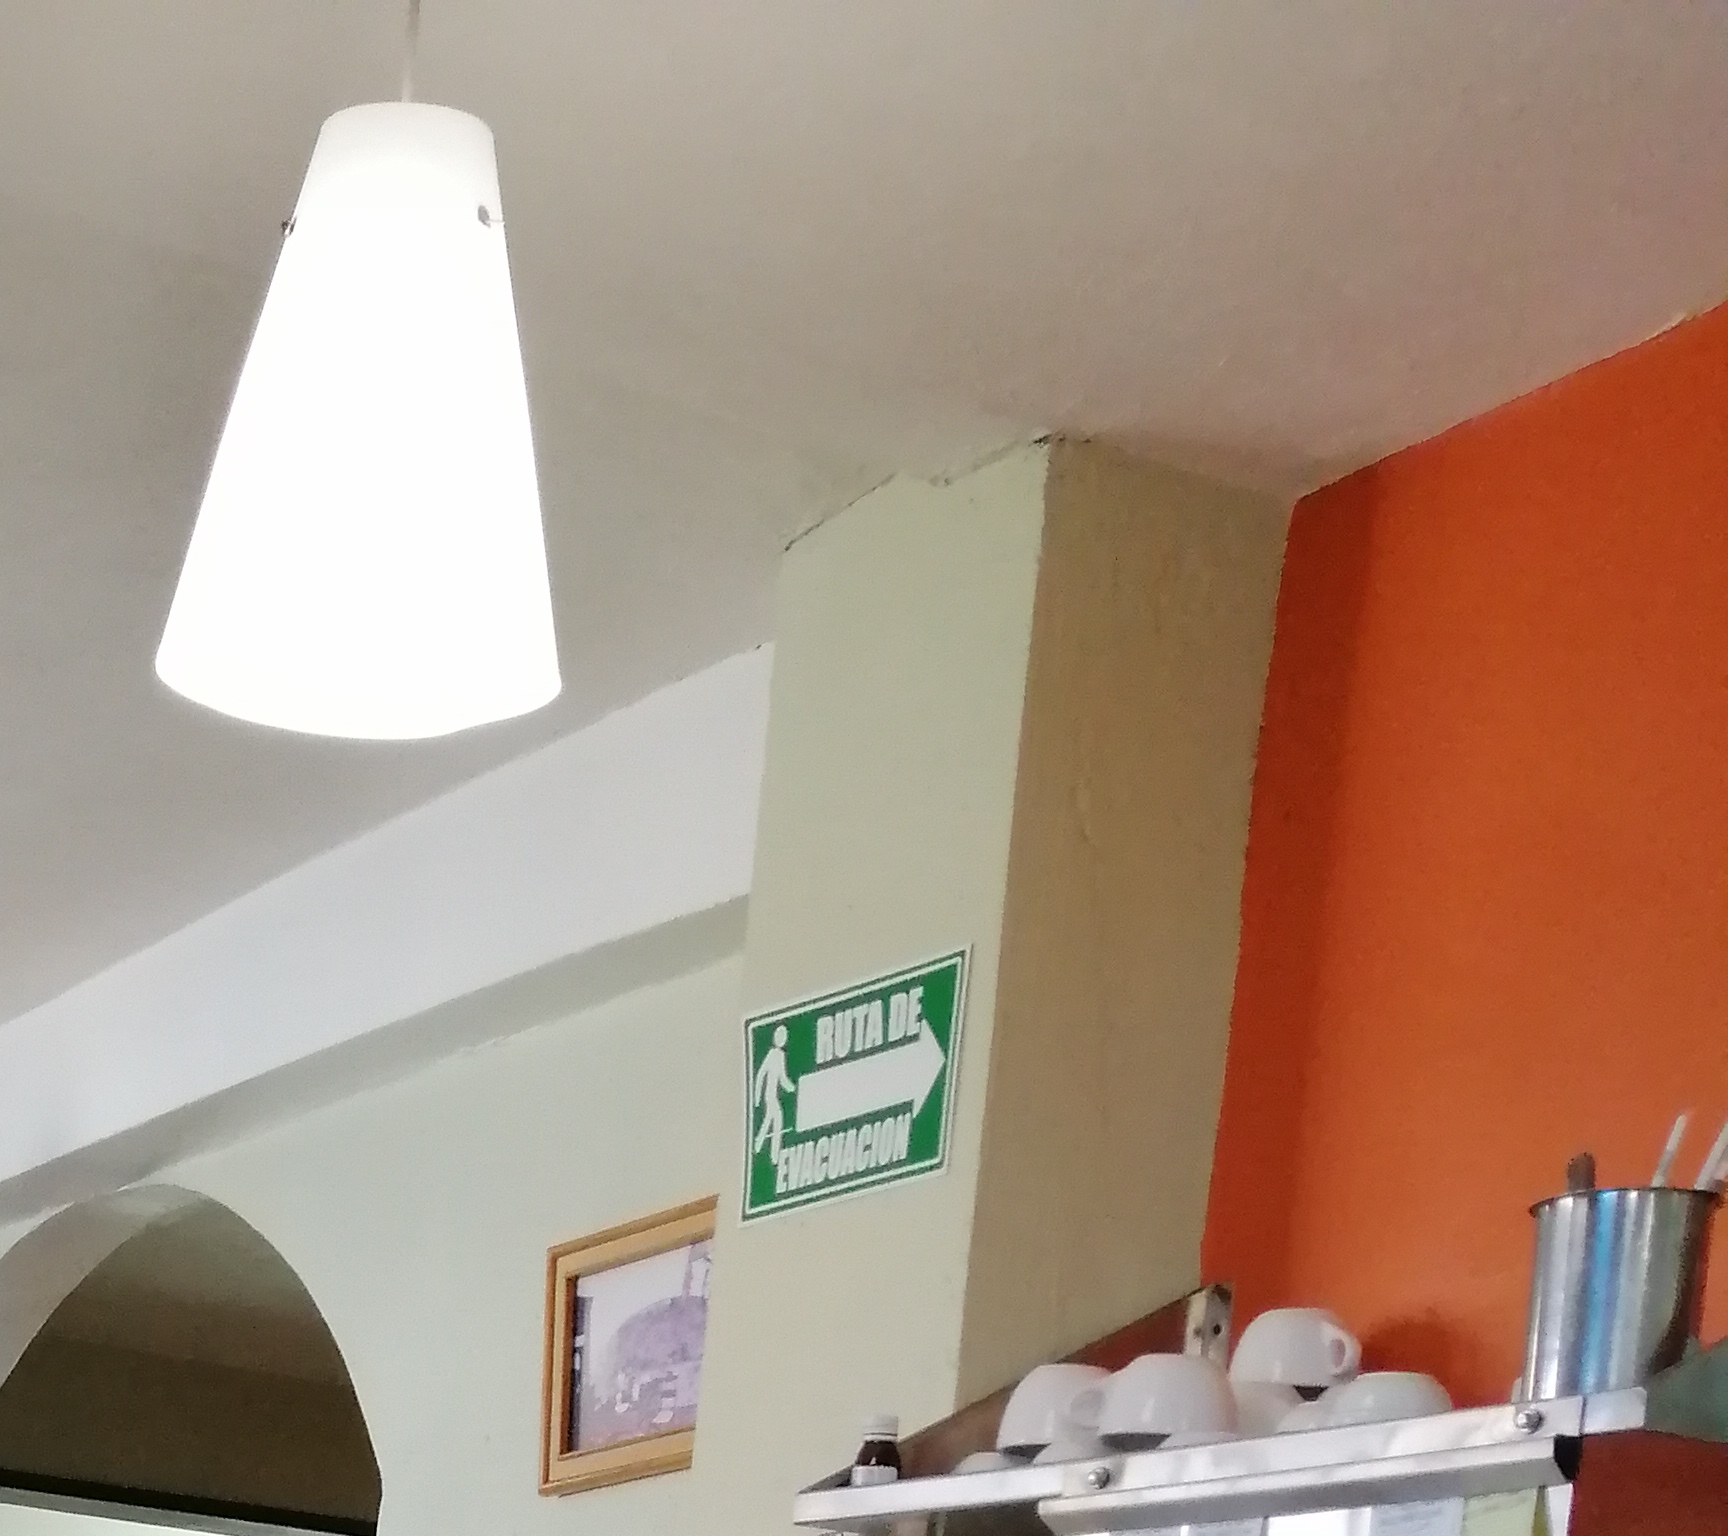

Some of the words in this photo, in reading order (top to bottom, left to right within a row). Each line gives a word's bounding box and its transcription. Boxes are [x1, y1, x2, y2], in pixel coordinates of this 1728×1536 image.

[815, 1000, 883, 1065] RUTA
[888, 985, 924, 1042] DE
[776, 1112, 912, 1194] EVACUACION
